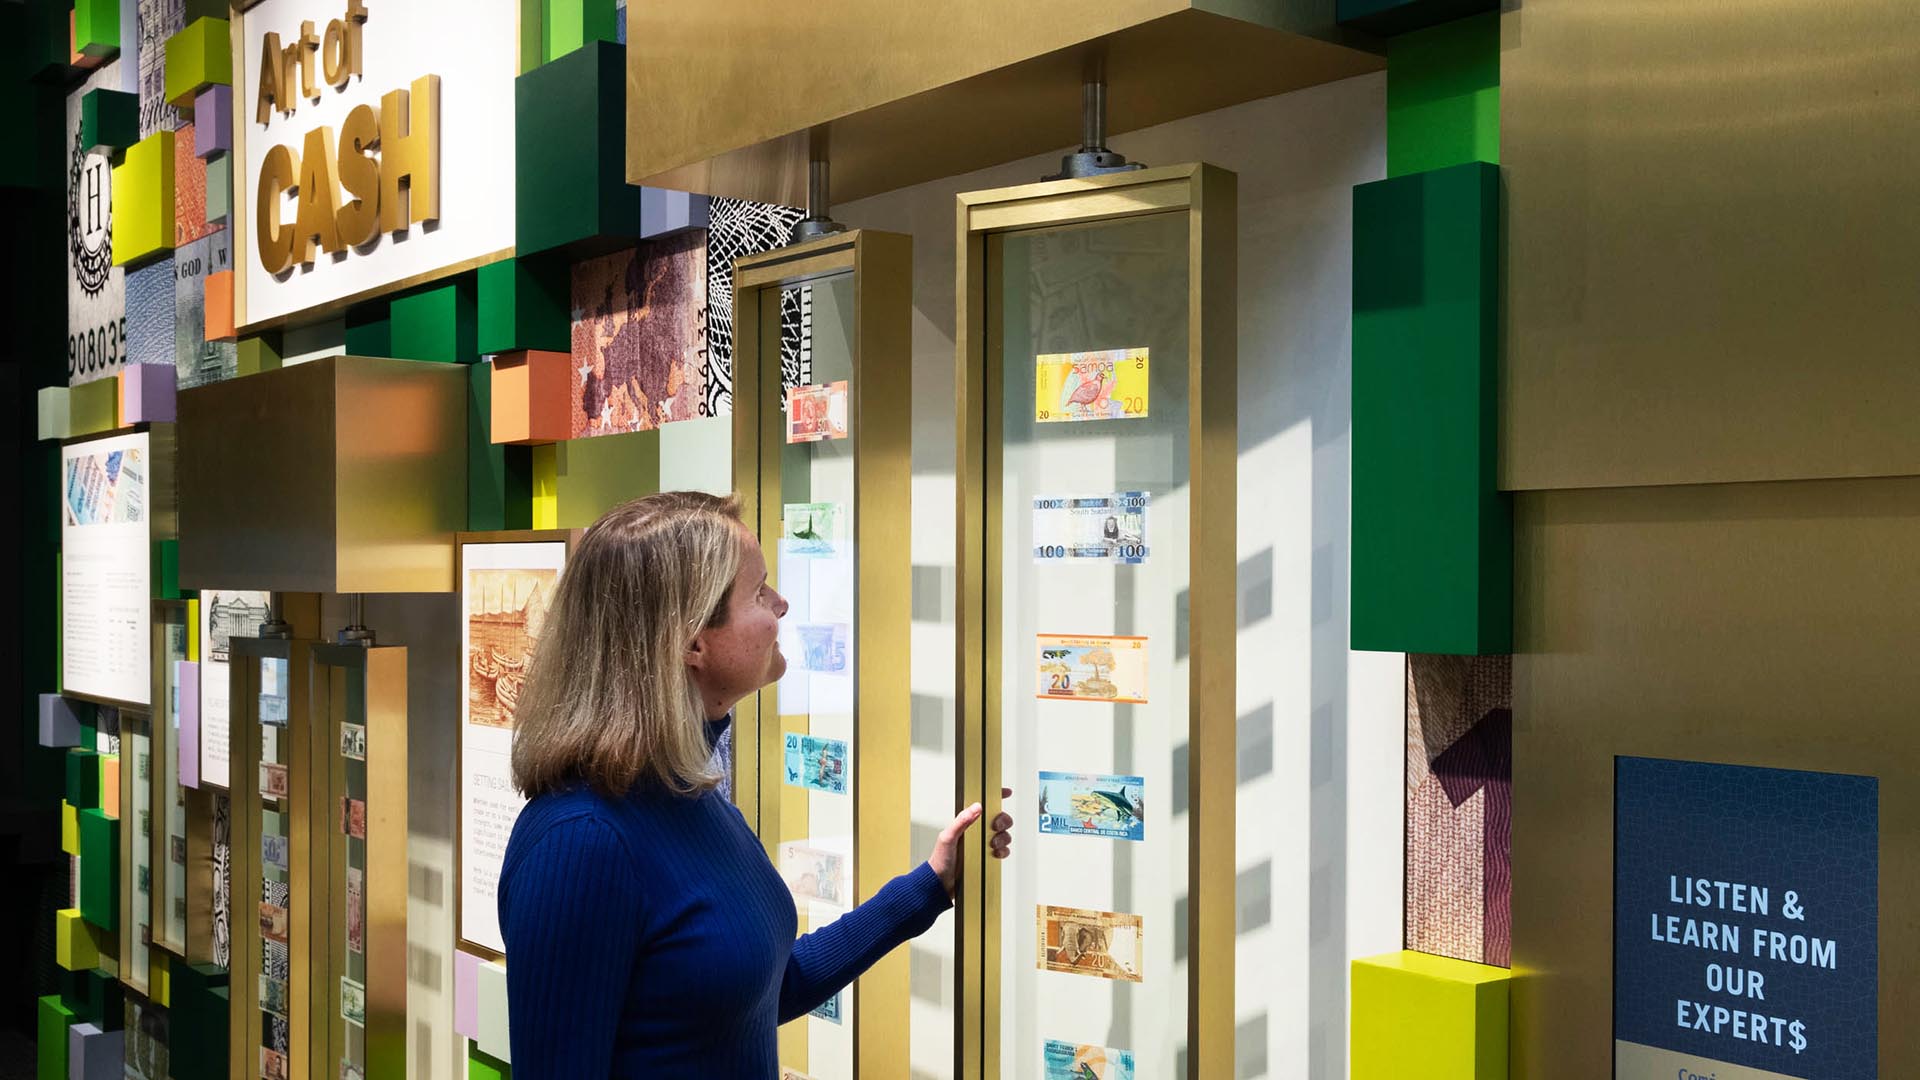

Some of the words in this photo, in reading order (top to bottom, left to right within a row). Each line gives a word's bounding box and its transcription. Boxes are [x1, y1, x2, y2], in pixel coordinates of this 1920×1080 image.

[256, 20, 320, 125] Art
[323, 0, 368, 87] of
[257, 74, 441, 273] CASH
[86, 163, 103, 236] H
[181, 257, 201, 279] GOD
[1135, 356, 1144, 369] 20
[1123, 397, 1144, 414] 20
[1039, 410, 1050, 419] 20
[1039, 500, 1057, 509] 100
[1126, 498, 1146, 508] 100
[1040, 545, 1065, 558] 100
[1119, 544, 1146, 558] 100
[1051, 673, 1071, 689] 20
[786, 735, 798, 749] 20
[1041, 813, 1052, 832] 2
[1052, 816, 1069, 827] MIL
[1670, 875, 1768, 915] LISTEN
[1782, 890, 1805, 921] &
[1652, 913, 1739, 953] LEARN
[1753, 929, 1836, 969] FROM
[1091, 953, 1105, 968] 20
[1706, 963, 1764, 1000] OUR
[1677, 999, 1808, 1054] EXPERT$
